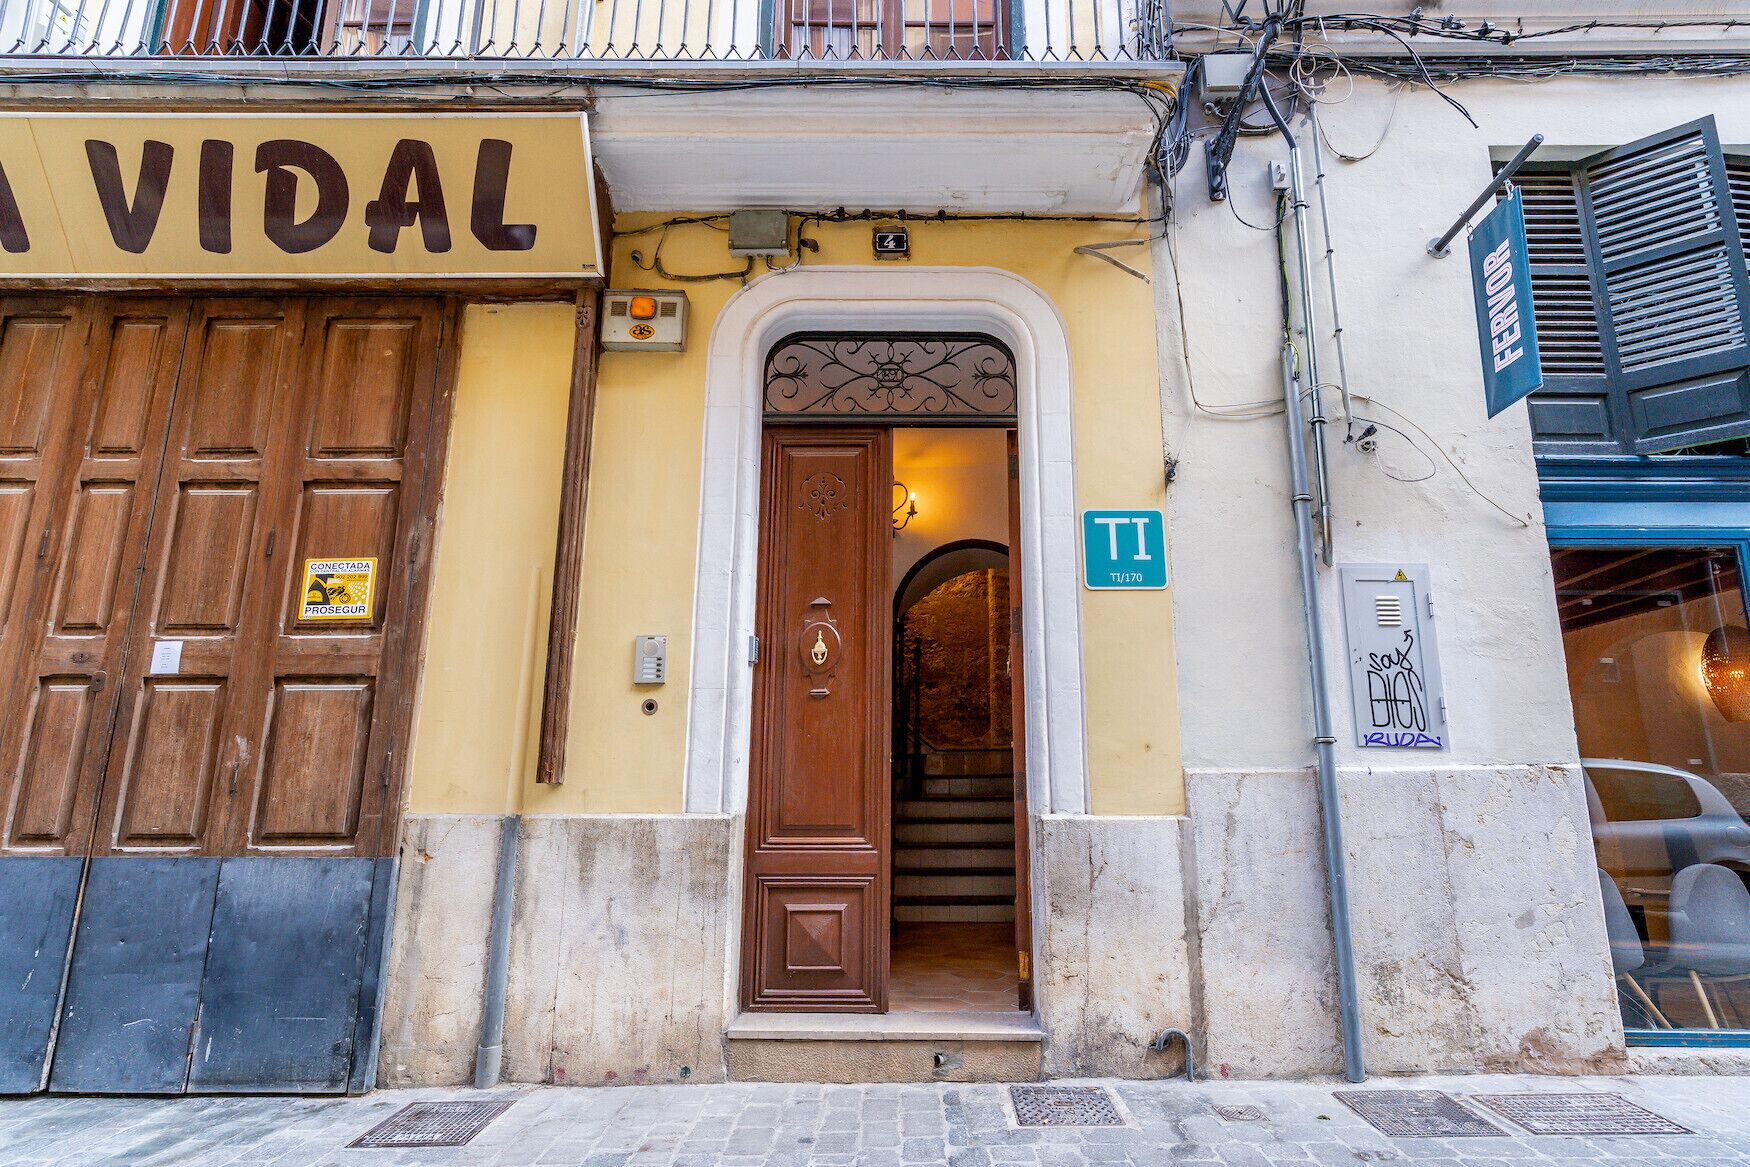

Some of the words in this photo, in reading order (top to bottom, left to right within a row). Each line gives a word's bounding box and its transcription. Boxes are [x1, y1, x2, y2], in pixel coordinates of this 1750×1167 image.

[85, 139, 537, 254] VIDAL
[884, 235, 896, 249] 4
[1483, 238, 1523, 373] FERVOR
[1094, 517, 1152, 560] TI
[310, 562, 370, 570] CONECTADA
[1110, 573, 1143, 584] TI/170
[304, 605, 366, 615] PROSEGUR
[1367, 670, 1426, 732] DIOS
